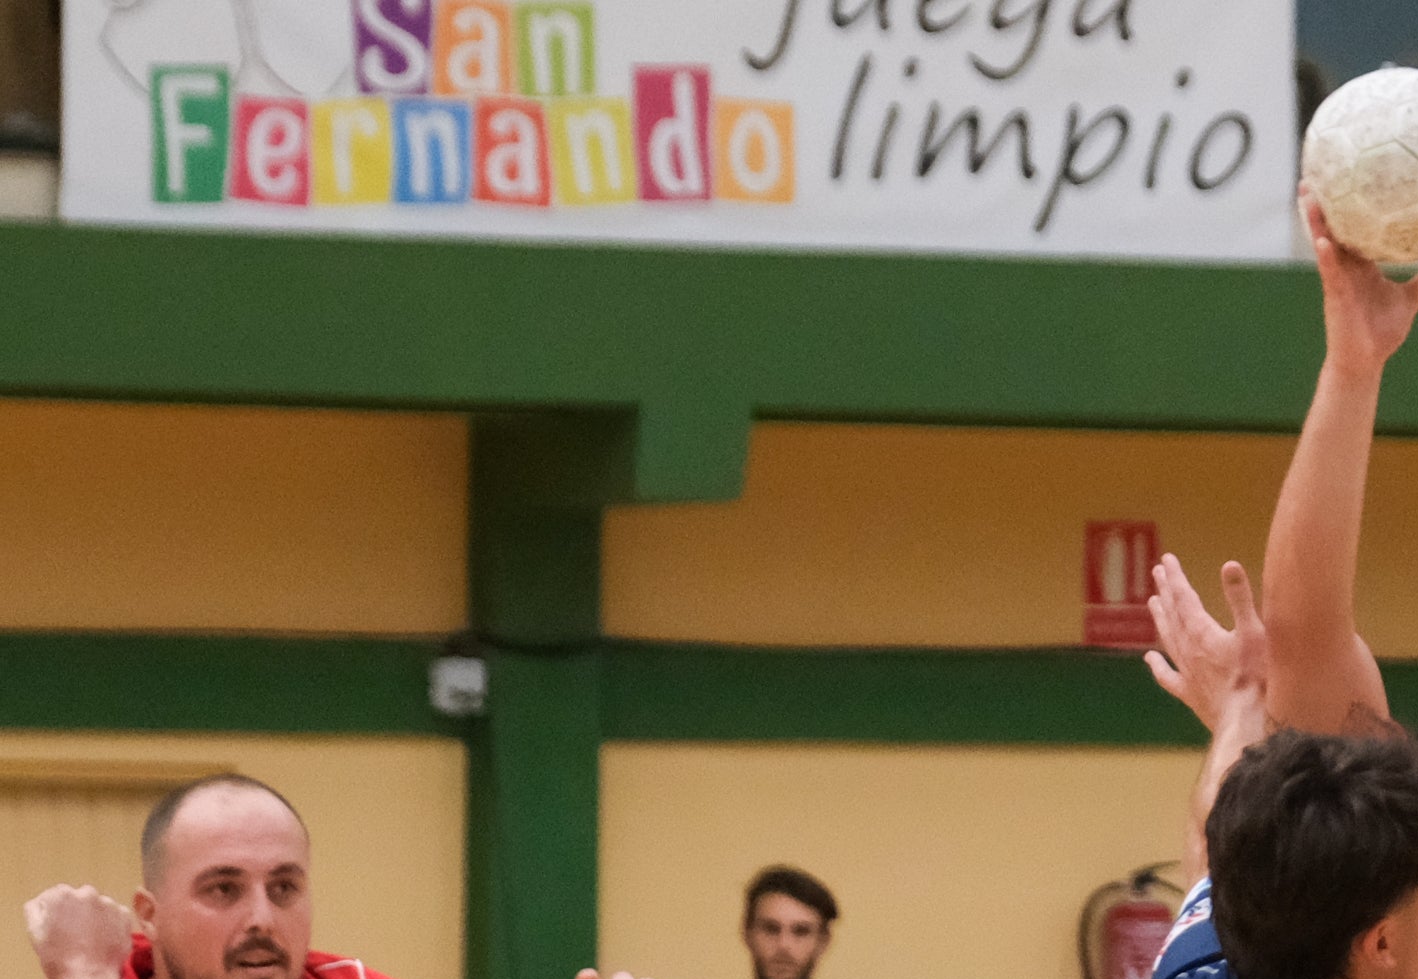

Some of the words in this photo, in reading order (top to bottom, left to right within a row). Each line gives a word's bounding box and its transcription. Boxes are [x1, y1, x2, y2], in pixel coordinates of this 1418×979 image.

[362, 0, 584, 92] San
[158, 68, 782, 197] Fernando
[830, 50, 1256, 234] limpio
